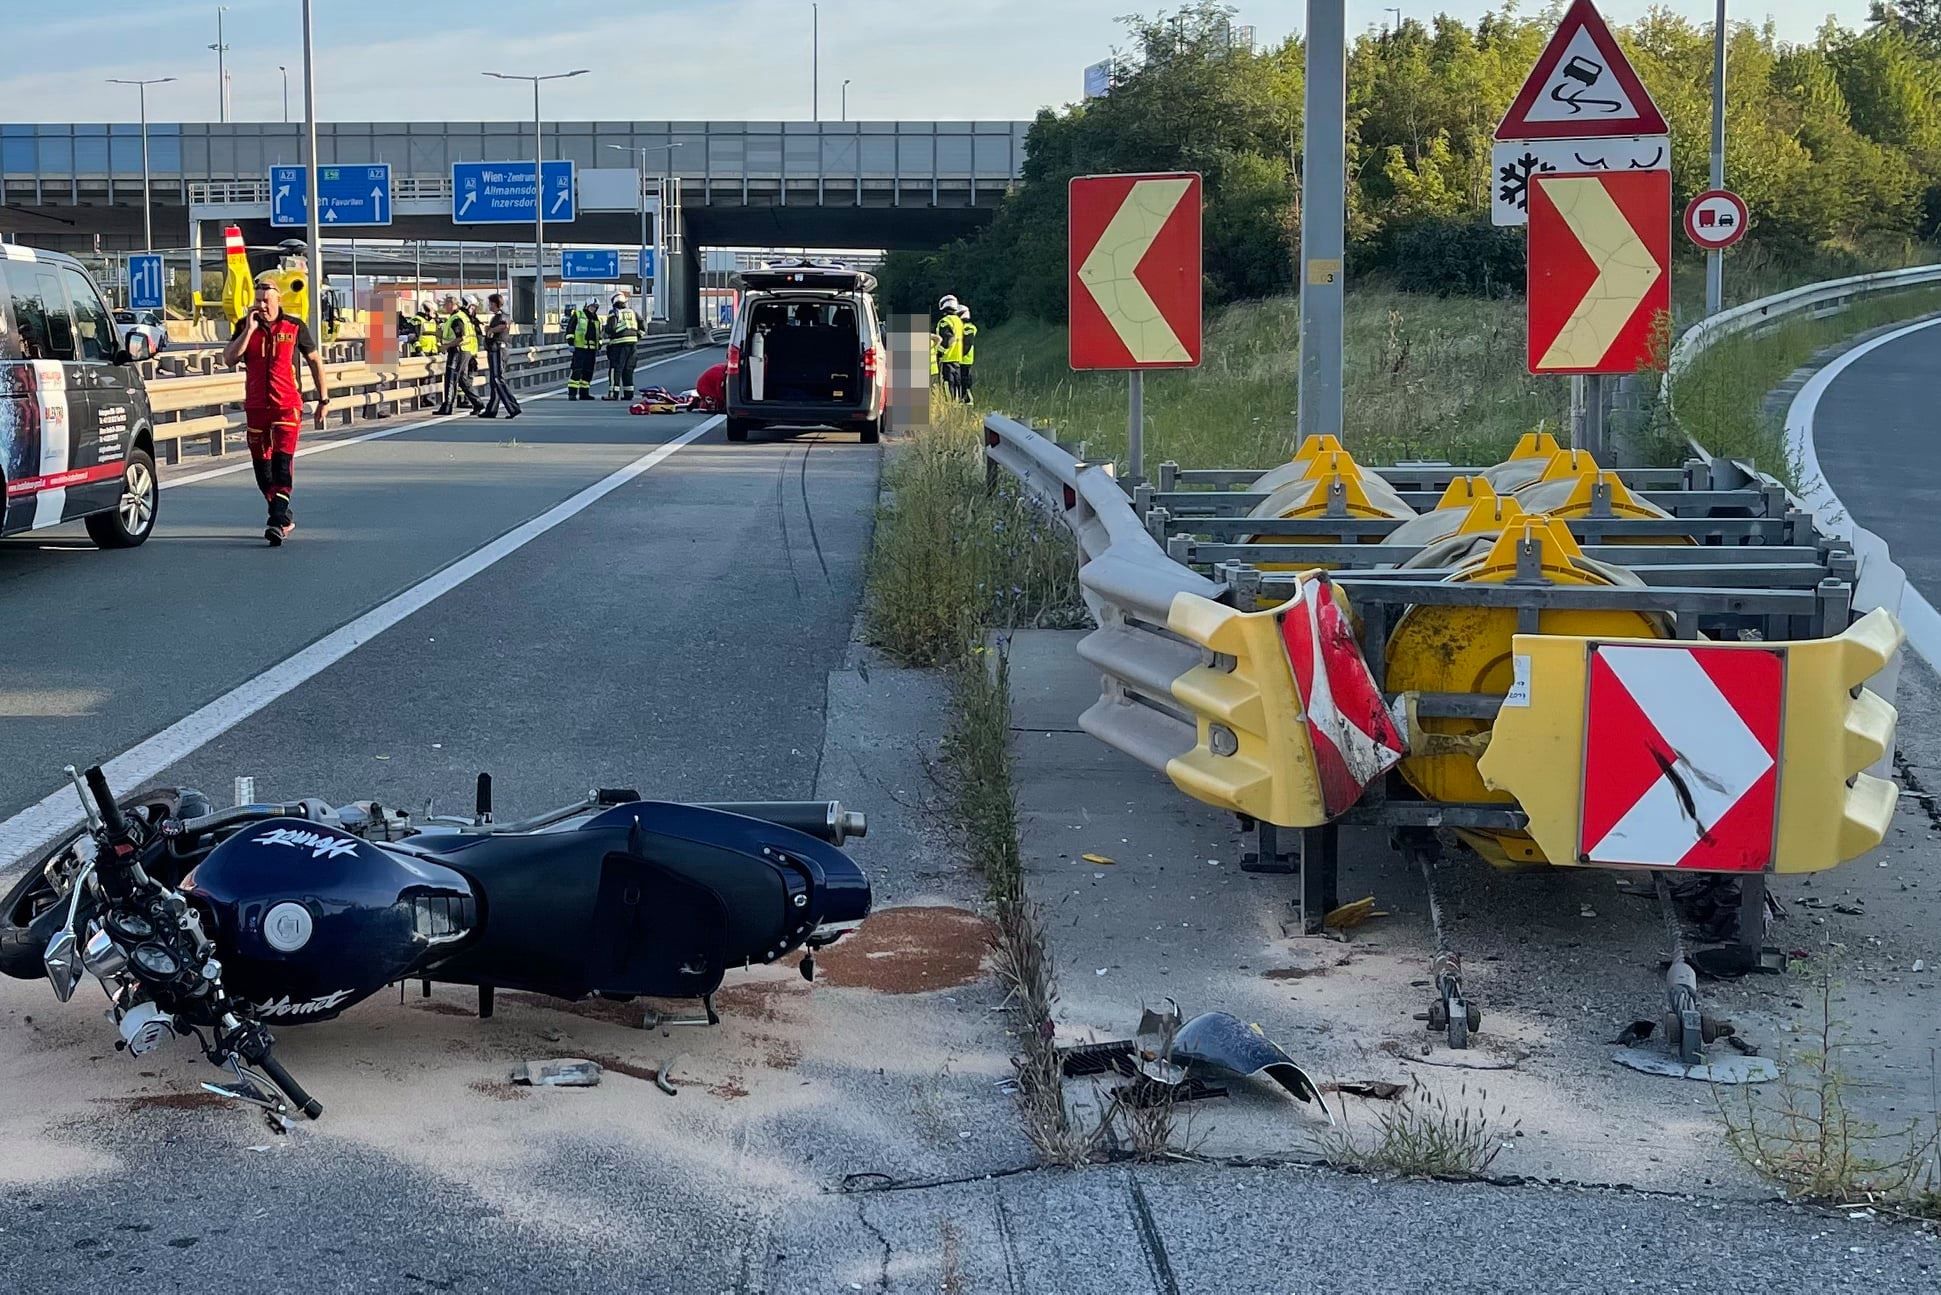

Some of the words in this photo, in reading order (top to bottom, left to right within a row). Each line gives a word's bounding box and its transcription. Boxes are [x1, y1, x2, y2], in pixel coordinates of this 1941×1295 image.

[280, 171, 295, 180] A23
[369, 169, 384, 178] A23
[484, 185, 544, 195] Altmannsdof
[251, 828, 360, 859] Hornet
[255, 988, 355, 1017] Hornet
